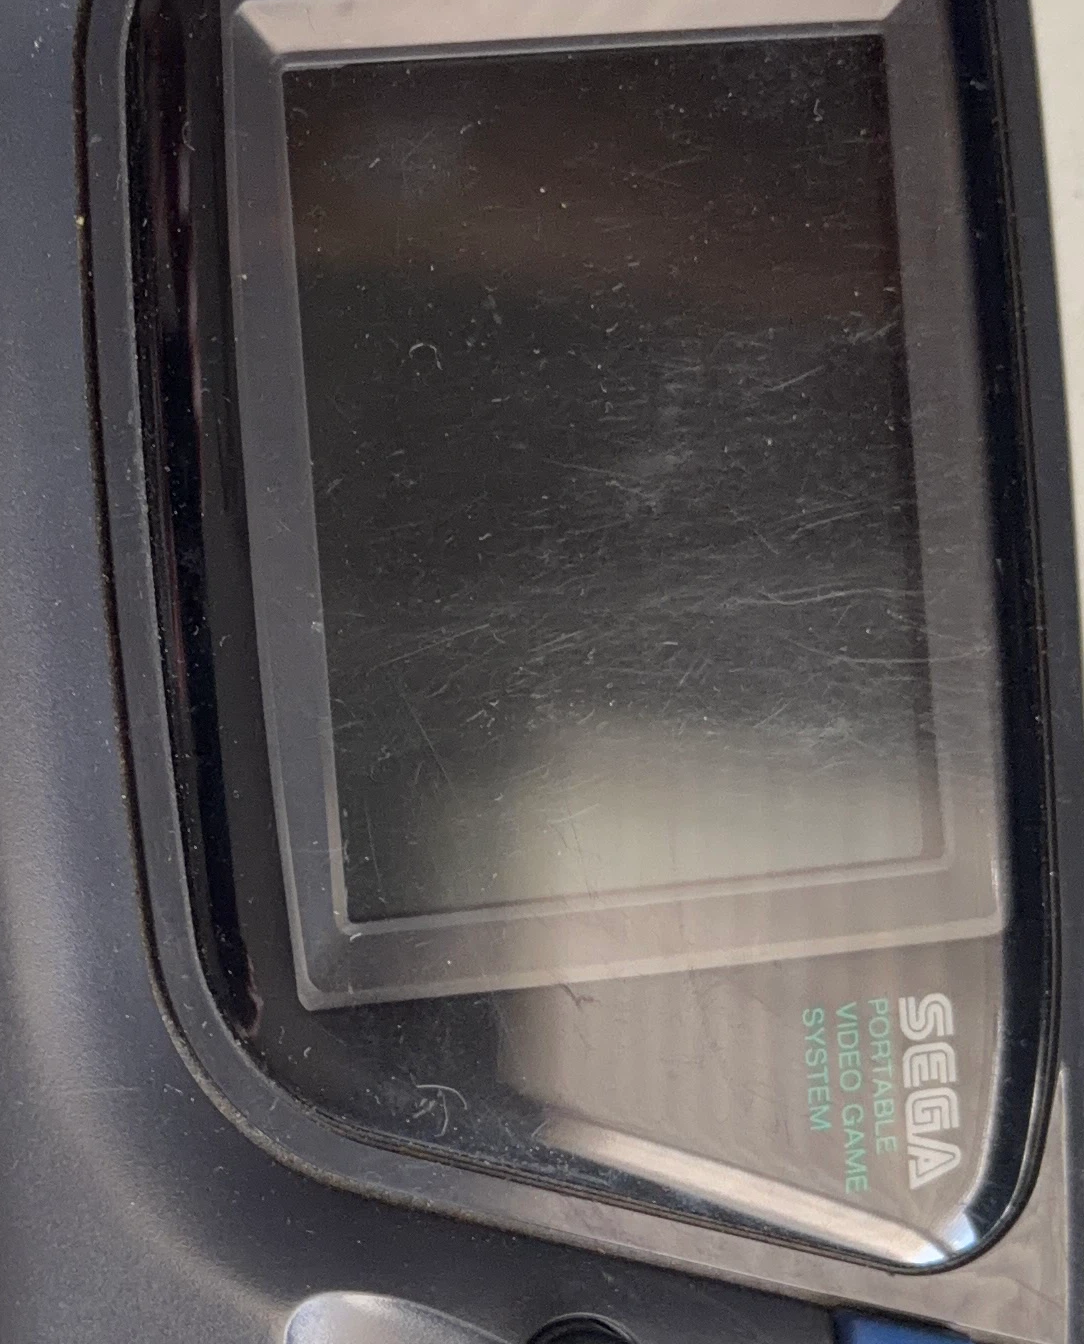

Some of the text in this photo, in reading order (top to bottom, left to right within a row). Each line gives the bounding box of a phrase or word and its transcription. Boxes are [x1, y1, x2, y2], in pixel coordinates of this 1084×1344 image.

[802, 1007, 832, 1131] SYSTEM
[836, 1002, 870, 1194] VIDEO GAME
[868, 998, 897, 1155] PORTABLE
[898, 992, 961, 1190] SEGA
